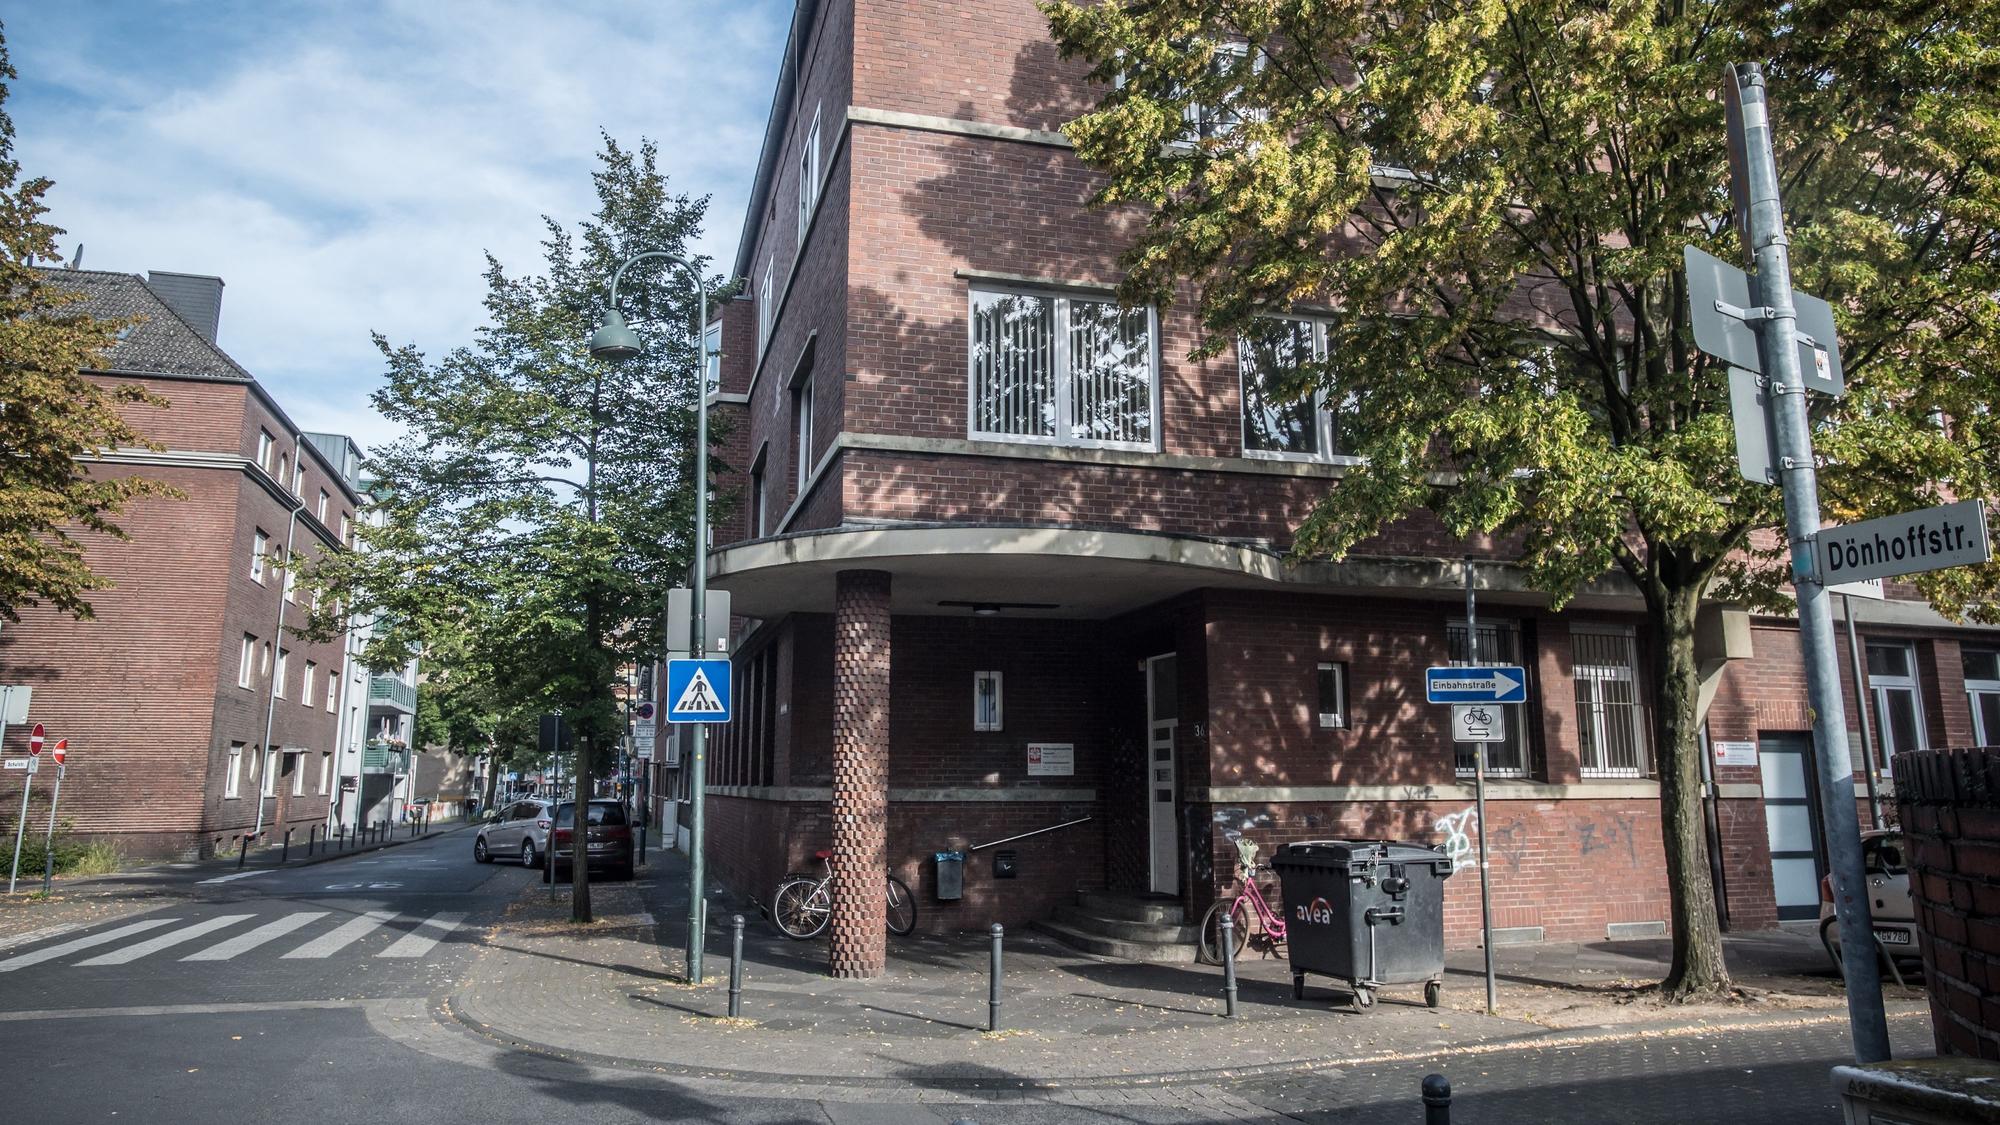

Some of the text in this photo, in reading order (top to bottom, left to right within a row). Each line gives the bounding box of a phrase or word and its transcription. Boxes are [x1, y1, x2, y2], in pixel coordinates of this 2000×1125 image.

[1828, 521, 1973, 571] Dönhoffstr.
[1432, 681, 1496, 689] Einbahnstraße
[1194, 725, 1205, 737] 36
[1296, 900, 1331, 925] avea
